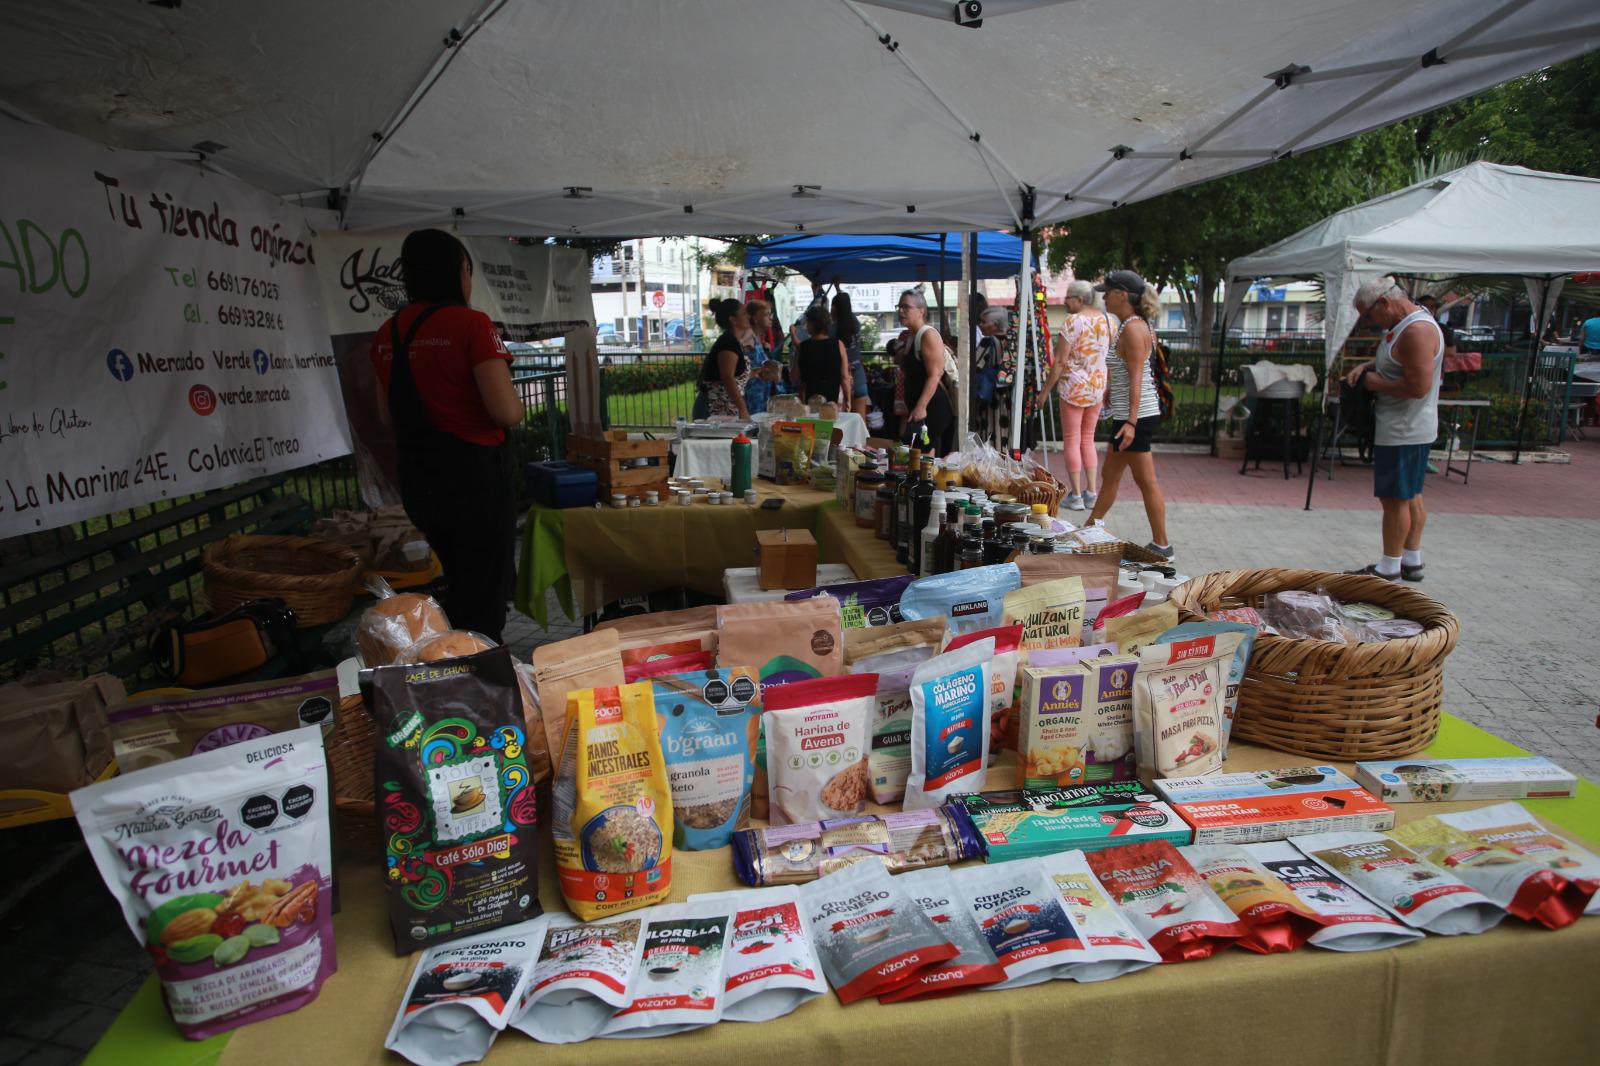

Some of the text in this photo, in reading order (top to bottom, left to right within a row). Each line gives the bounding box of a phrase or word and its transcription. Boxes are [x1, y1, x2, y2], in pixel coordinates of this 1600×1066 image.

[94, 171, 239, 247] Tu tienda
[138, 350, 252, 373] Mercado Verde
[6, 479, 40, 512] La
[46, 463, 129, 505] Marina
[267, 437, 300, 456] Toreo
[953, 601, 988, 613] KIRKLAND
[1177, 645, 1209, 659] SIN GLUTEN
[935, 682, 976, 707] MARINO
[1042, 700, 1080, 711] Annie's
[1098, 704, 1132, 715] ORGANI
[794, 721, 850, 737] Harina de
[1038, 716, 1080, 727] ORGANIC
[1161, 716, 1215, 740] MASA PARA PIZZA
[804, 736, 842, 750] Avena
[882, 735, 902, 745] GUAR
[246, 742, 295, 764] DELICIOSA
[670, 767, 710, 782] granola
[671, 782, 694, 793] keto
[1024, 786, 1098, 806] CAULIFLOWER
[1183, 803, 1241, 813] Banza
[1031, 815, 1096, 828] Spaghetti
[117, 820, 252, 871] Mezcla
[436, 840, 507, 866] Café Sólo Dios
[130, 839, 281, 899] Gourmet
[1099, 858, 1172, 881] CAYENA
[974, 886, 1025, 903] CITRATO
[1133, 883, 1168, 897] NATURAL
[811, 891, 891, 924] MAGNESIO
[820, 890, 872, 911] CITRATO
[973, 889, 1032, 912] POTASIO
[843, 912, 878, 927] NATURAL
[992, 905, 1026, 922] NATURAL
[1165, 923, 1208, 937] vizana
[550, 928, 620, 952] HEMP
[467, 947, 503, 956] SODIO
[1011, 946, 1048, 961] vizana
[877, 955, 920, 977] vizana
[737, 966, 782, 983] vizana
[920, 969, 964, 985] vizana
[192, 978, 224, 993] MEZCLA
[637, 998, 677, 1008] vizana
